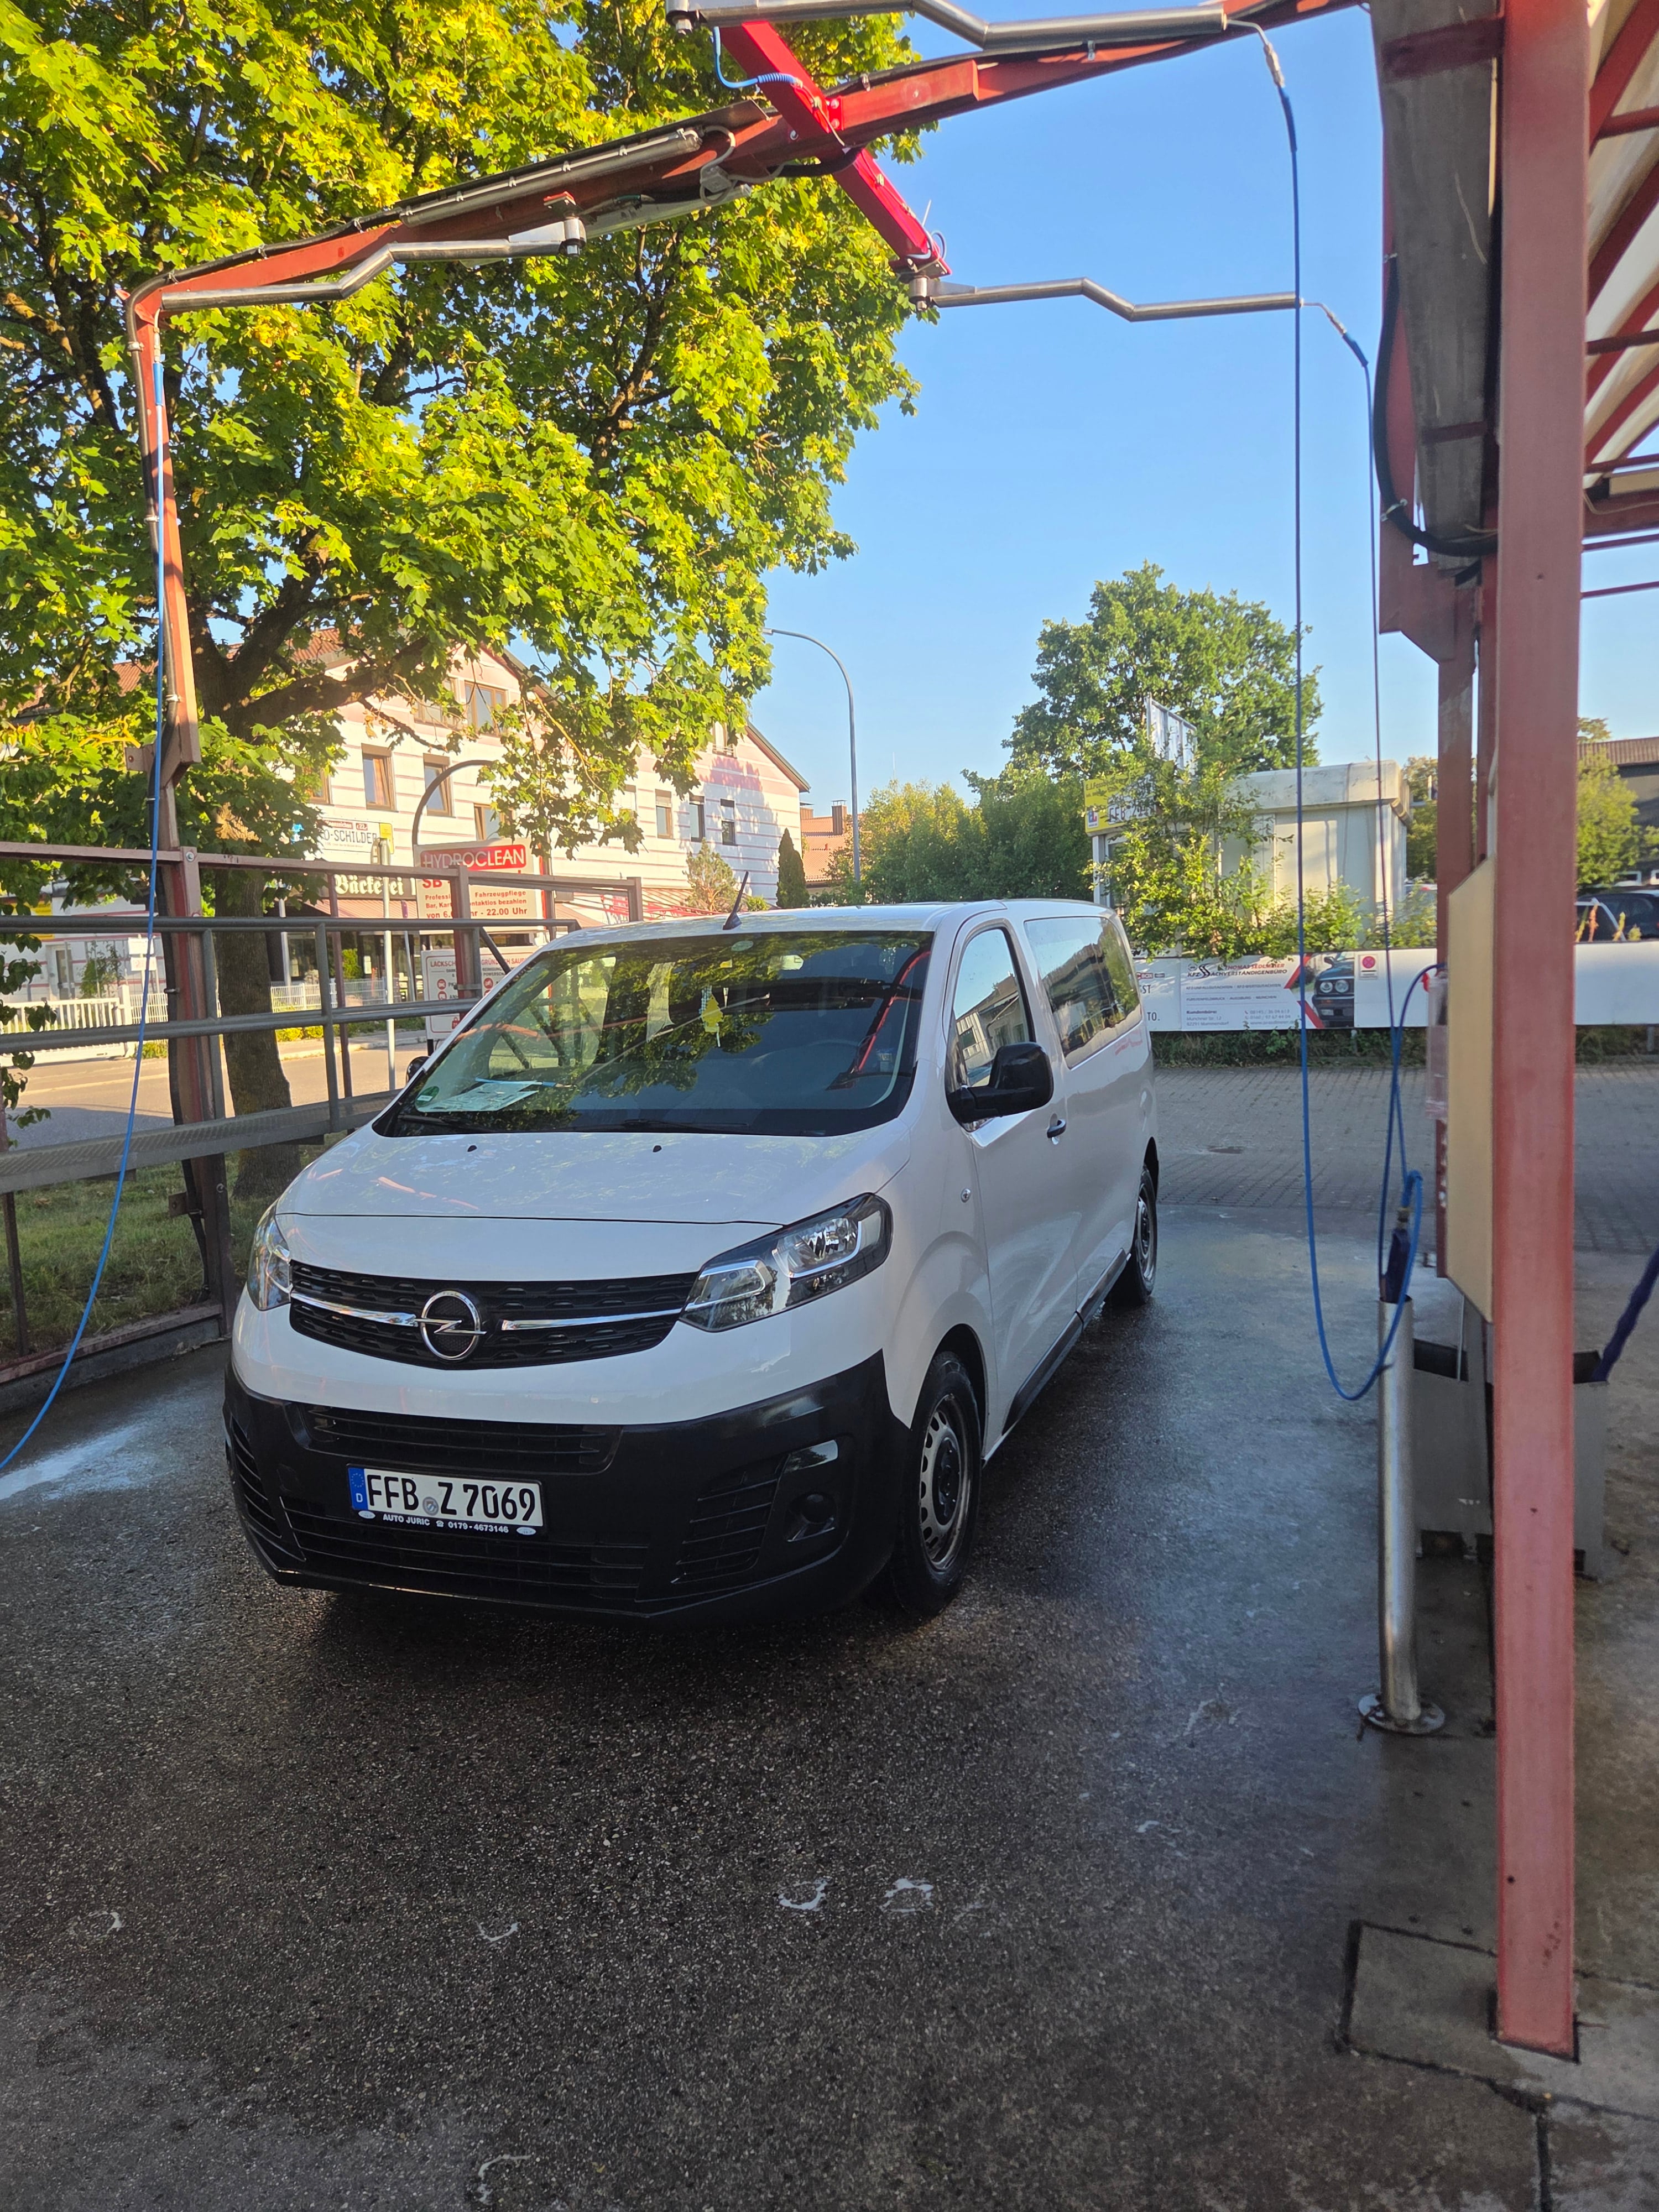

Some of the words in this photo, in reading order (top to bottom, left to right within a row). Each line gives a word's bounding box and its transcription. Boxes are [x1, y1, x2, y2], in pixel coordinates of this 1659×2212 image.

[324, 829, 377, 844] O-SCHILDER
[424, 848, 525, 868] HYDROCLEAN
[333, 874, 404, 895] Bäckeei
[422, 879, 442, 889] SB
[487, 907, 509, 916] 22.00
[356, 1493, 363, 1503] D
[367, 1474, 419, 1510] FFB
[437, 1481, 457, 1515] Z
[463, 1484, 535, 1521] 7069
[383, 1514, 404, 1522] AUTO
[406, 1517, 430, 1526] JURIC
